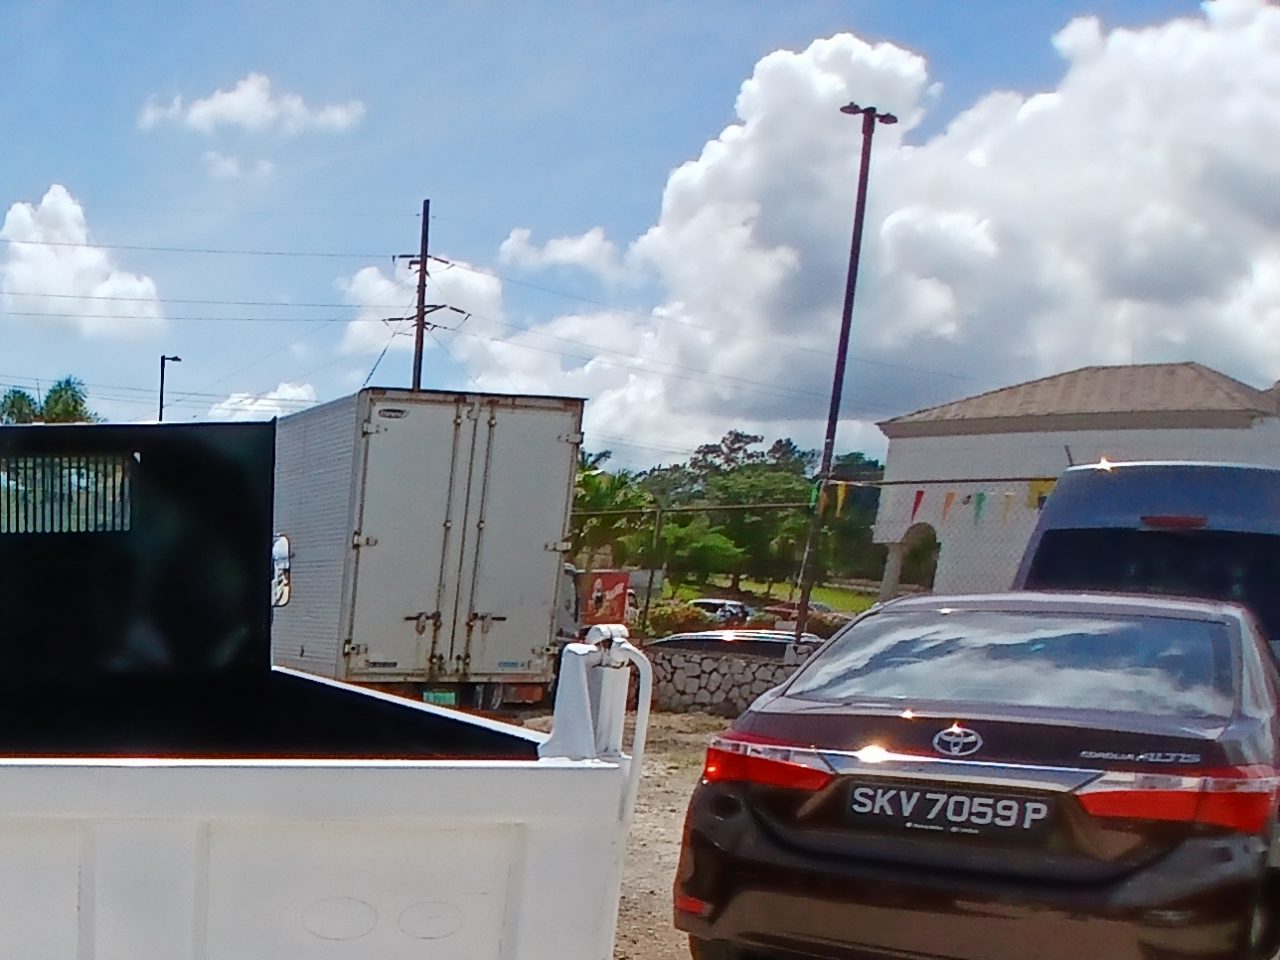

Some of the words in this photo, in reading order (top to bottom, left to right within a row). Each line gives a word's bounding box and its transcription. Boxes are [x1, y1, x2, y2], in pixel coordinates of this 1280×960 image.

[1135, 751, 1201, 763] ALTIS
[851, 787, 921, 817] SKV
[926, 793, 1019, 827] 7059
